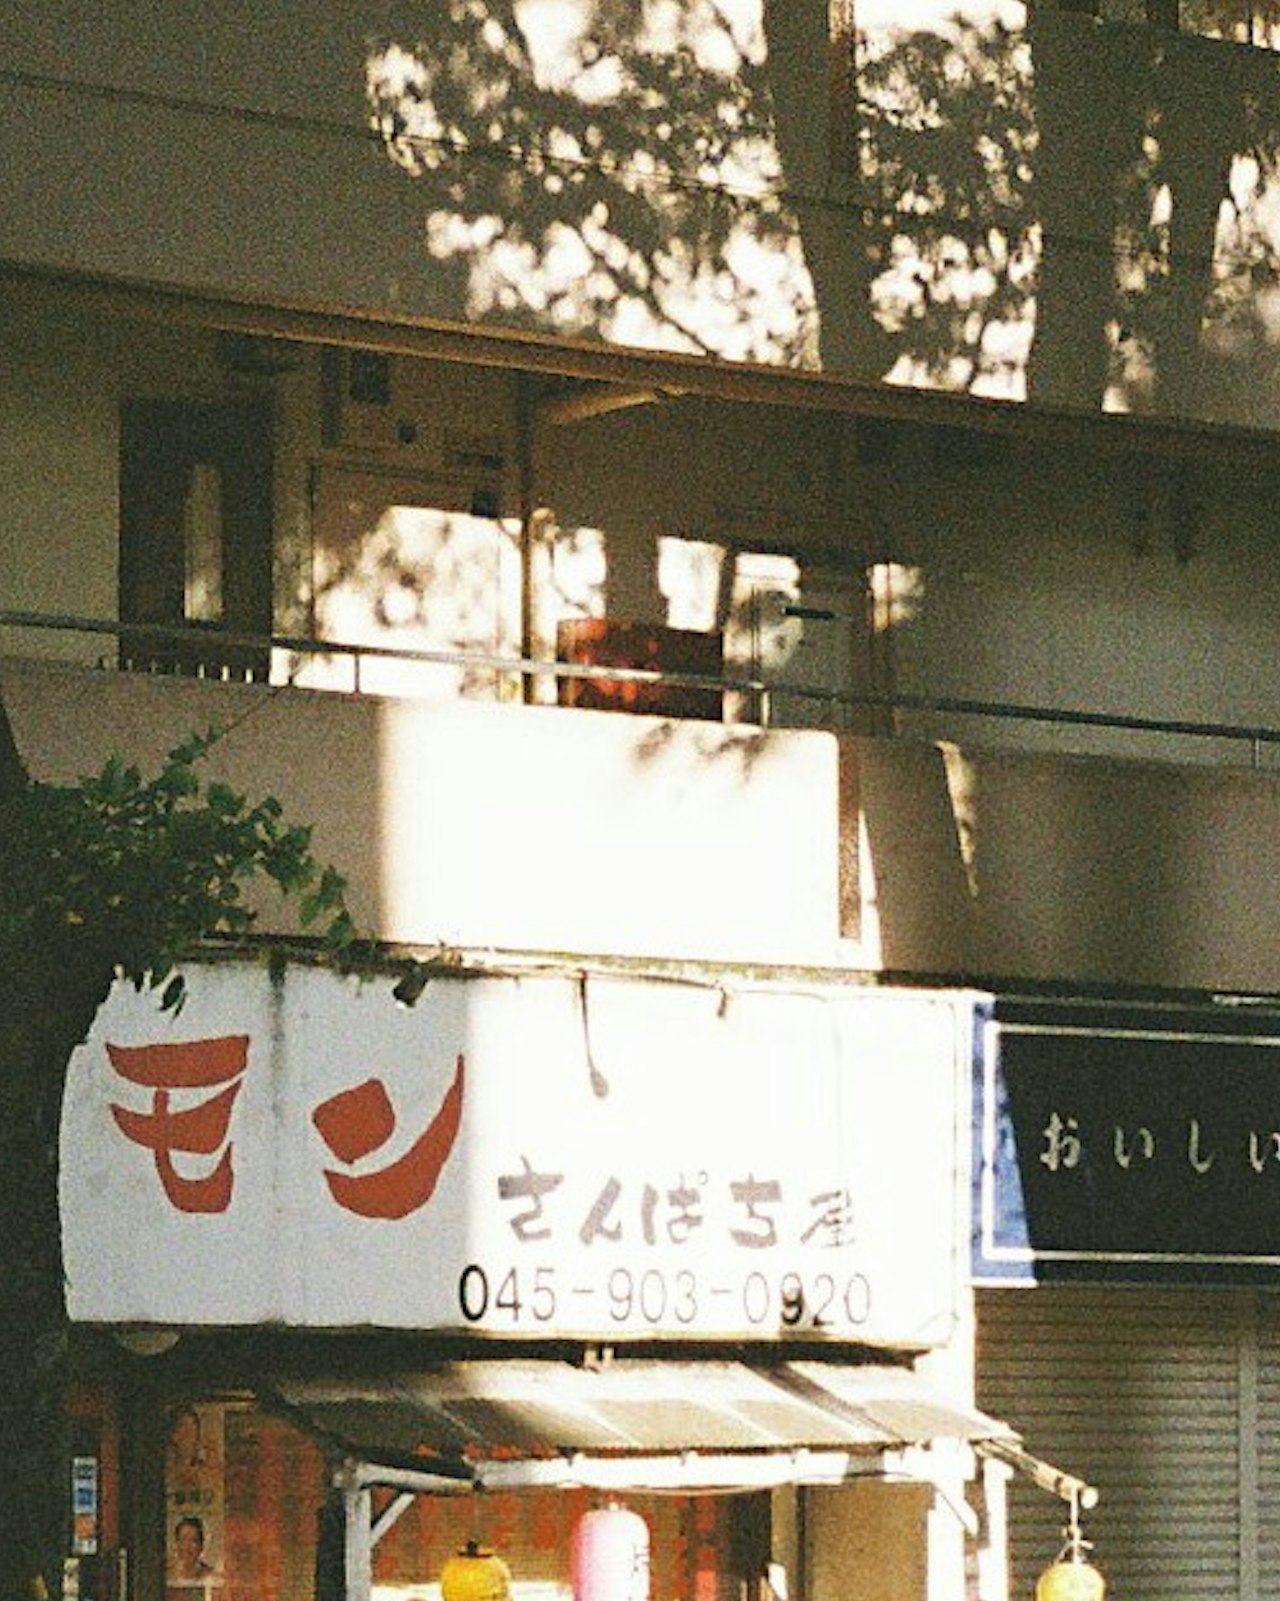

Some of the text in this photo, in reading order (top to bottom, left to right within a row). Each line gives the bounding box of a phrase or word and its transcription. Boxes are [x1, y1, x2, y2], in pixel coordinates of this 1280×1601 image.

[497, 1155, 855, 1248] さんぱち屋
[459, 1264, 871, 1326] 045-903-0920
